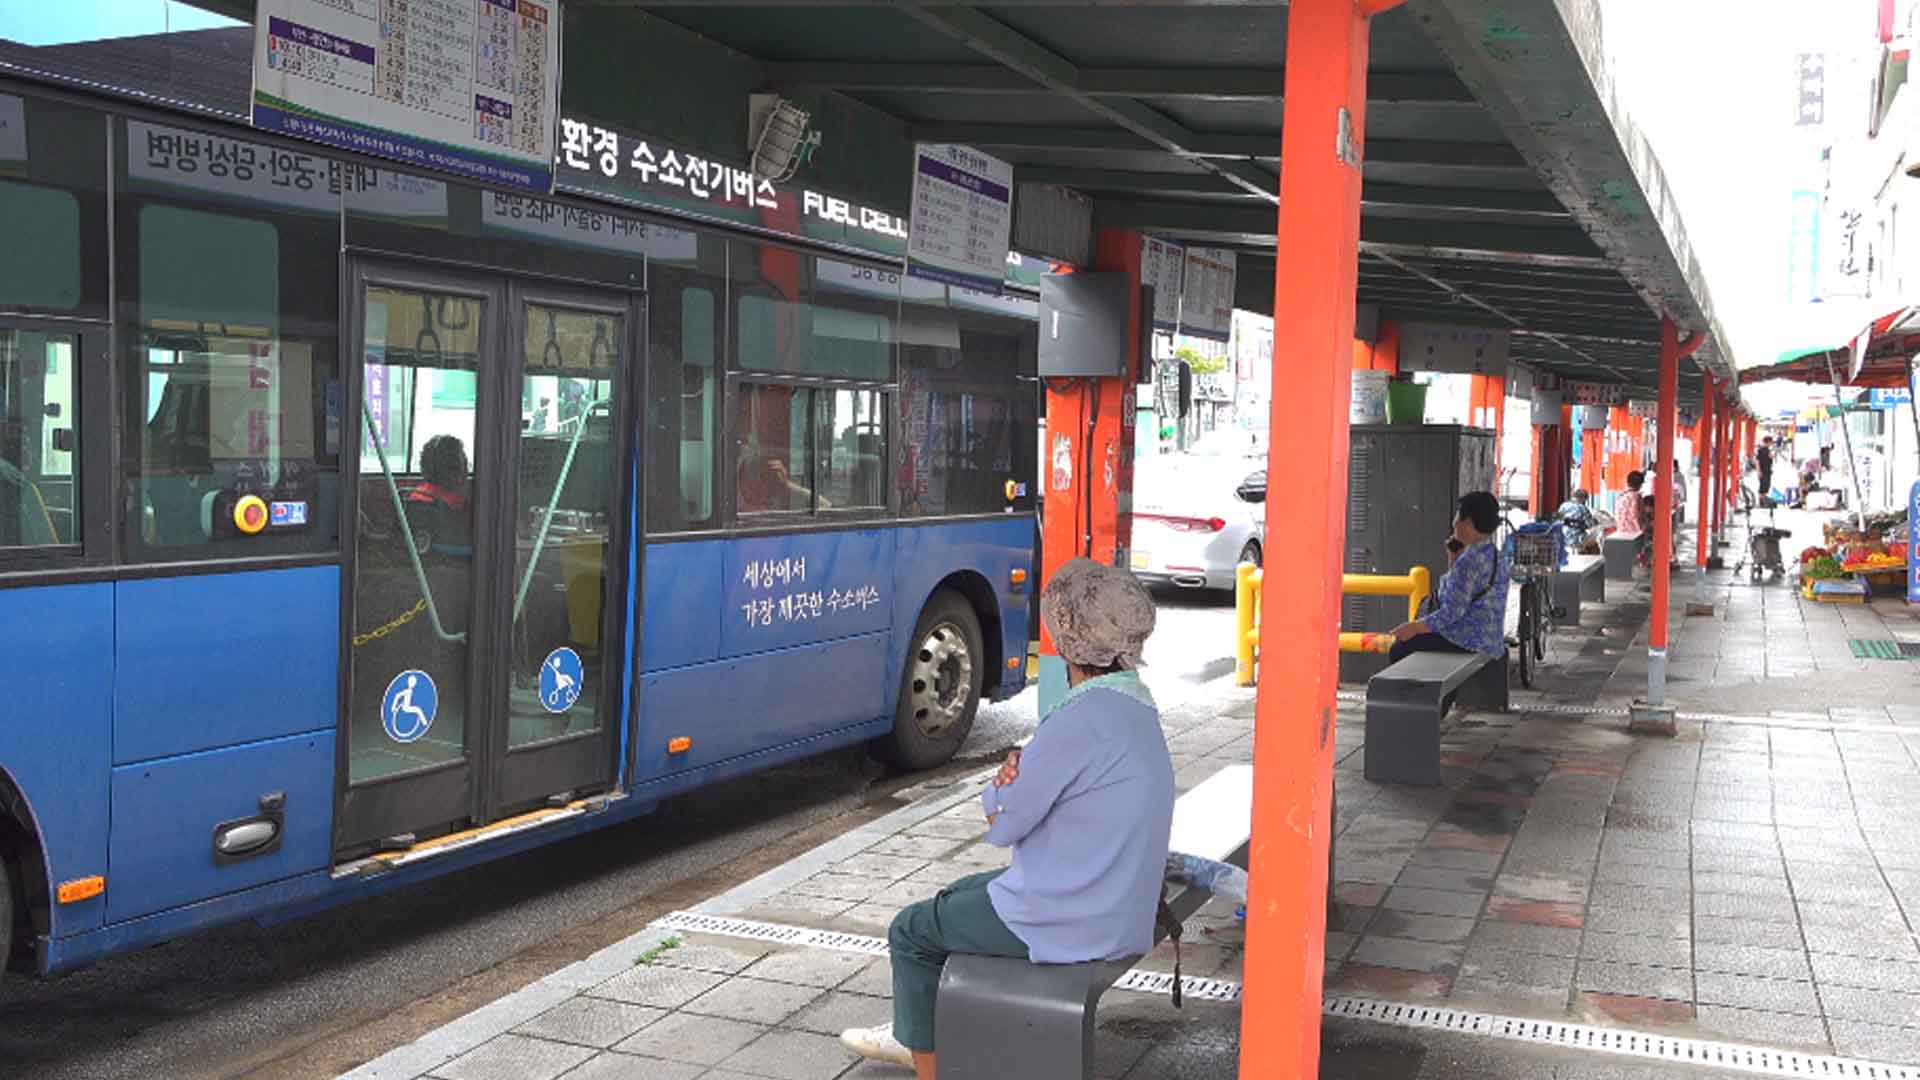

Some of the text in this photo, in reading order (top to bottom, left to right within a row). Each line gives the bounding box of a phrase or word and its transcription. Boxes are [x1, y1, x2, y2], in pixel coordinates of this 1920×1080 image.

[556, 118, 618, 178] 환경
[631, 142, 778, 209] 수소전기버스
[803, 190, 908, 238] FUEL CELL
[743, 557, 806, 588] 세상에서
[742, 598, 775, 628] 가장
